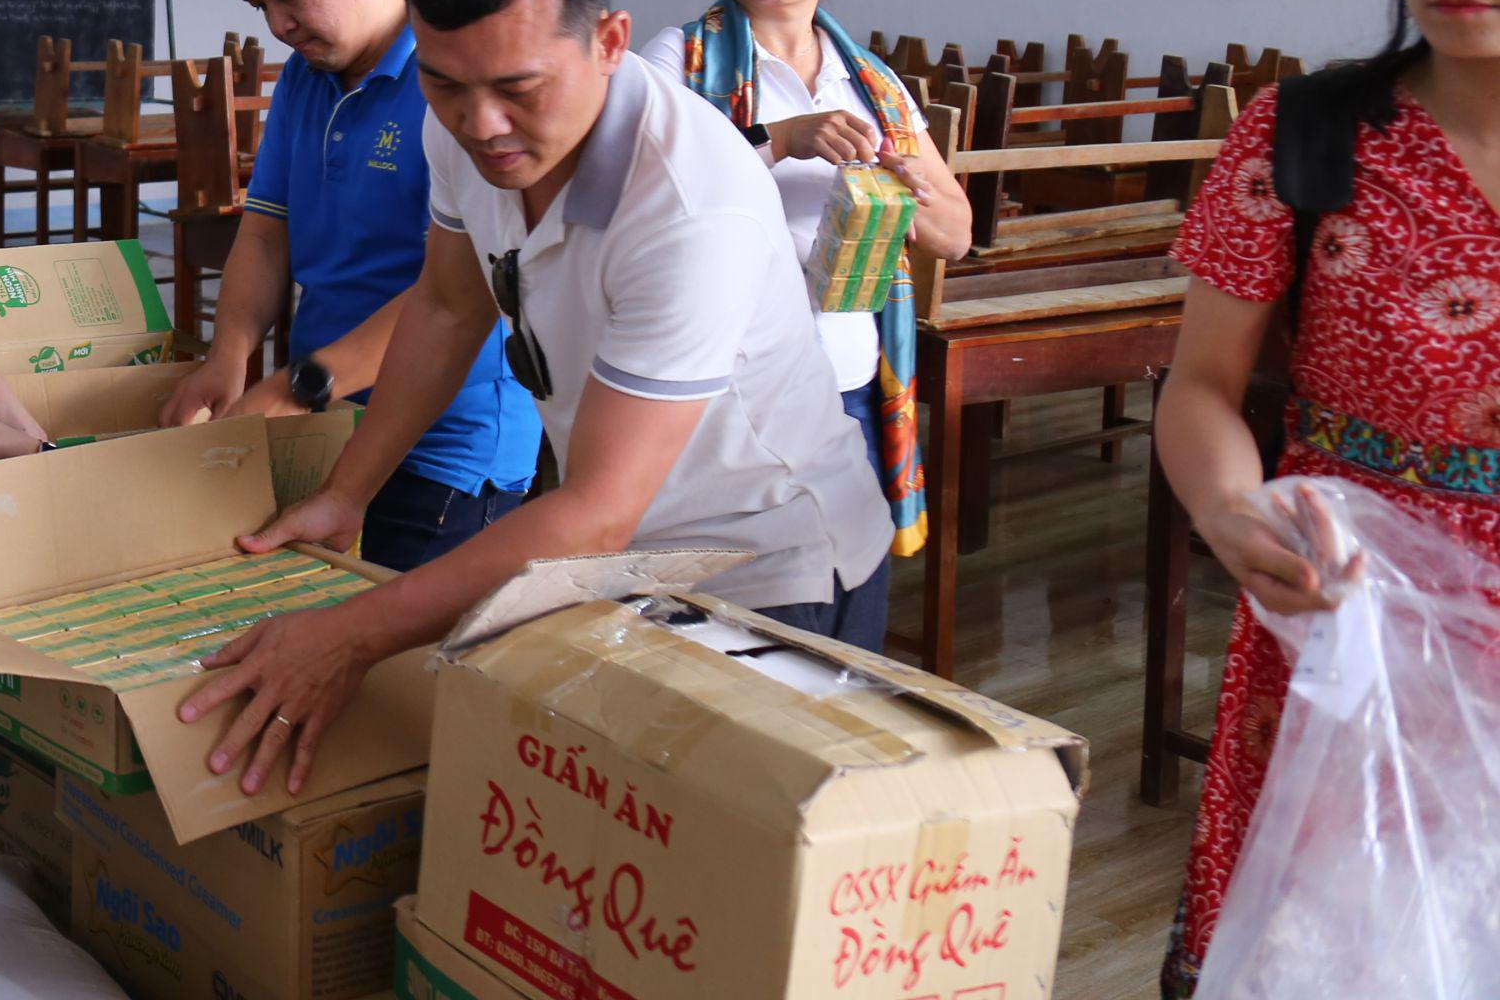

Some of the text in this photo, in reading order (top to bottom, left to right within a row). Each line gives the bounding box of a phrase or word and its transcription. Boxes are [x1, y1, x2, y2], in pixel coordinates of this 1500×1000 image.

[613, 780, 675, 849] ĂN
[188, 873, 244, 930] Creamer
[479, 779, 698, 972] Đồng Quê
[829, 861, 908, 916] CSSX
[142, 901, 182, 952] Sao
[834, 902, 1013, 991] Đồng Quê
